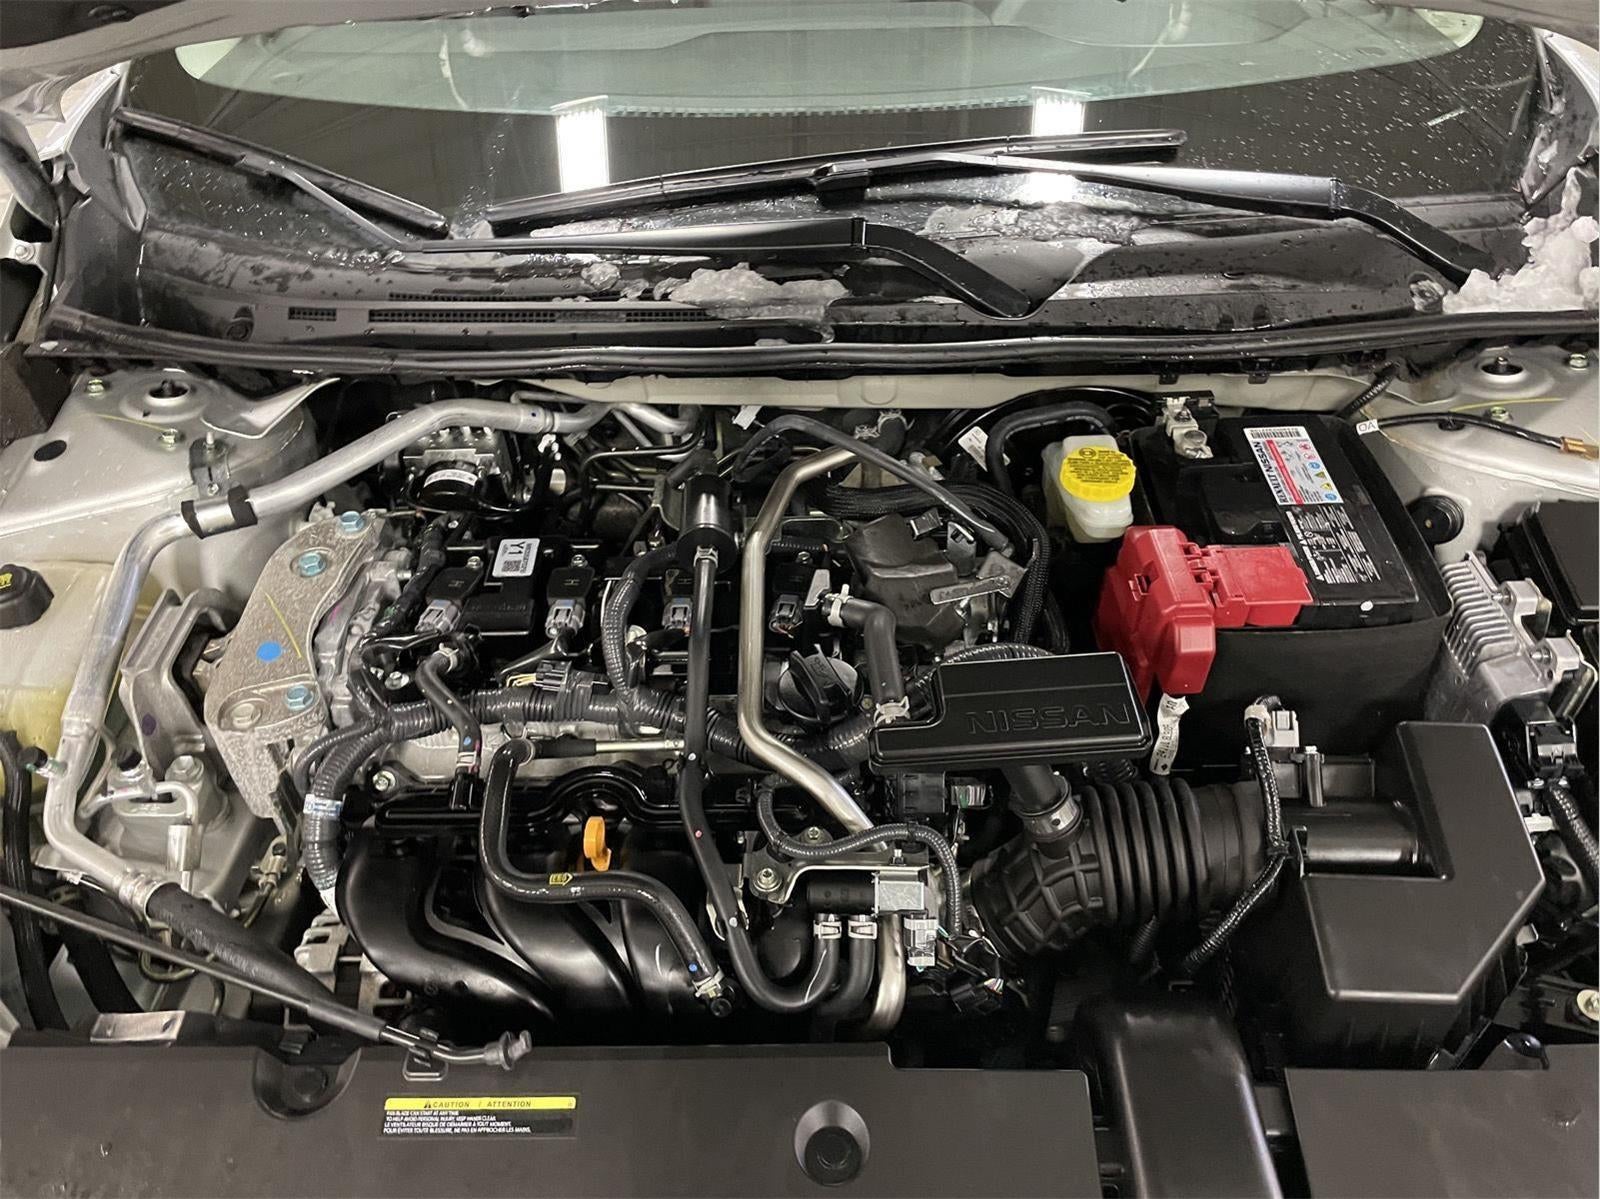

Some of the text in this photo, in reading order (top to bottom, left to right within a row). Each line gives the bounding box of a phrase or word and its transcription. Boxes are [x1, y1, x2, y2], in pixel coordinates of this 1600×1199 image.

[1253, 441, 1273, 473] NISSAN
[508, 541, 525, 554] Y1
[966, 703, 1130, 735] NISSAN
